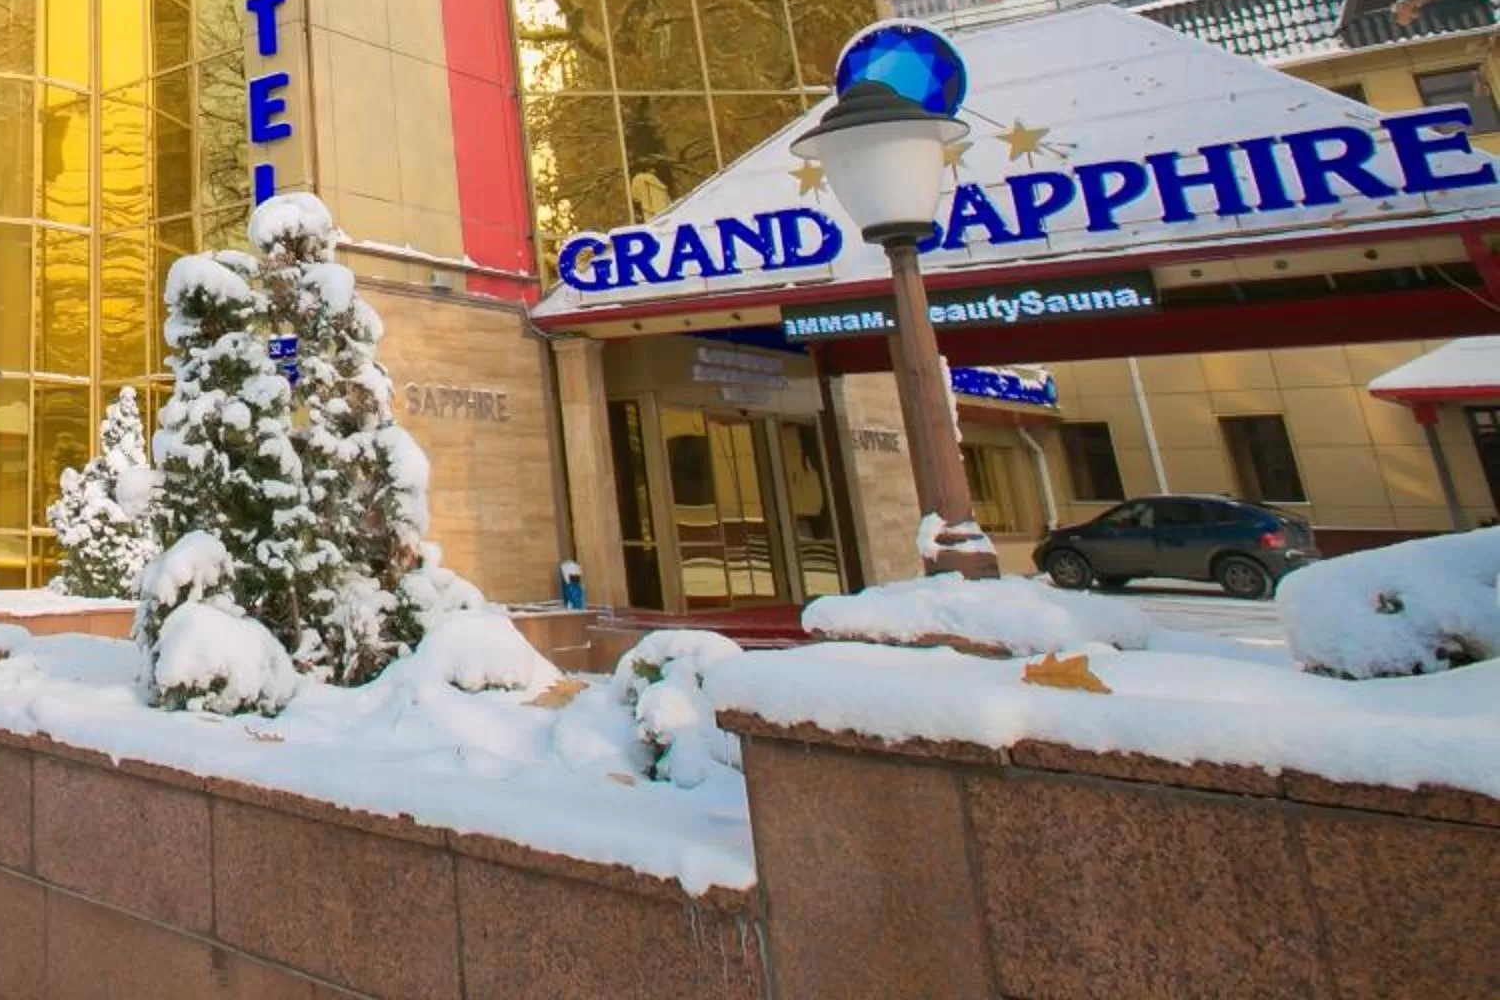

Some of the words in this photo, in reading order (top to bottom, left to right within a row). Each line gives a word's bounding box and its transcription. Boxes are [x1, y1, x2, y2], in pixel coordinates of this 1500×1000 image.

[558, 207, 843, 292] GRAND
[928, 287, 1154, 324] eautySauna.
[404, 382, 511, 422] SAPPHIRE
